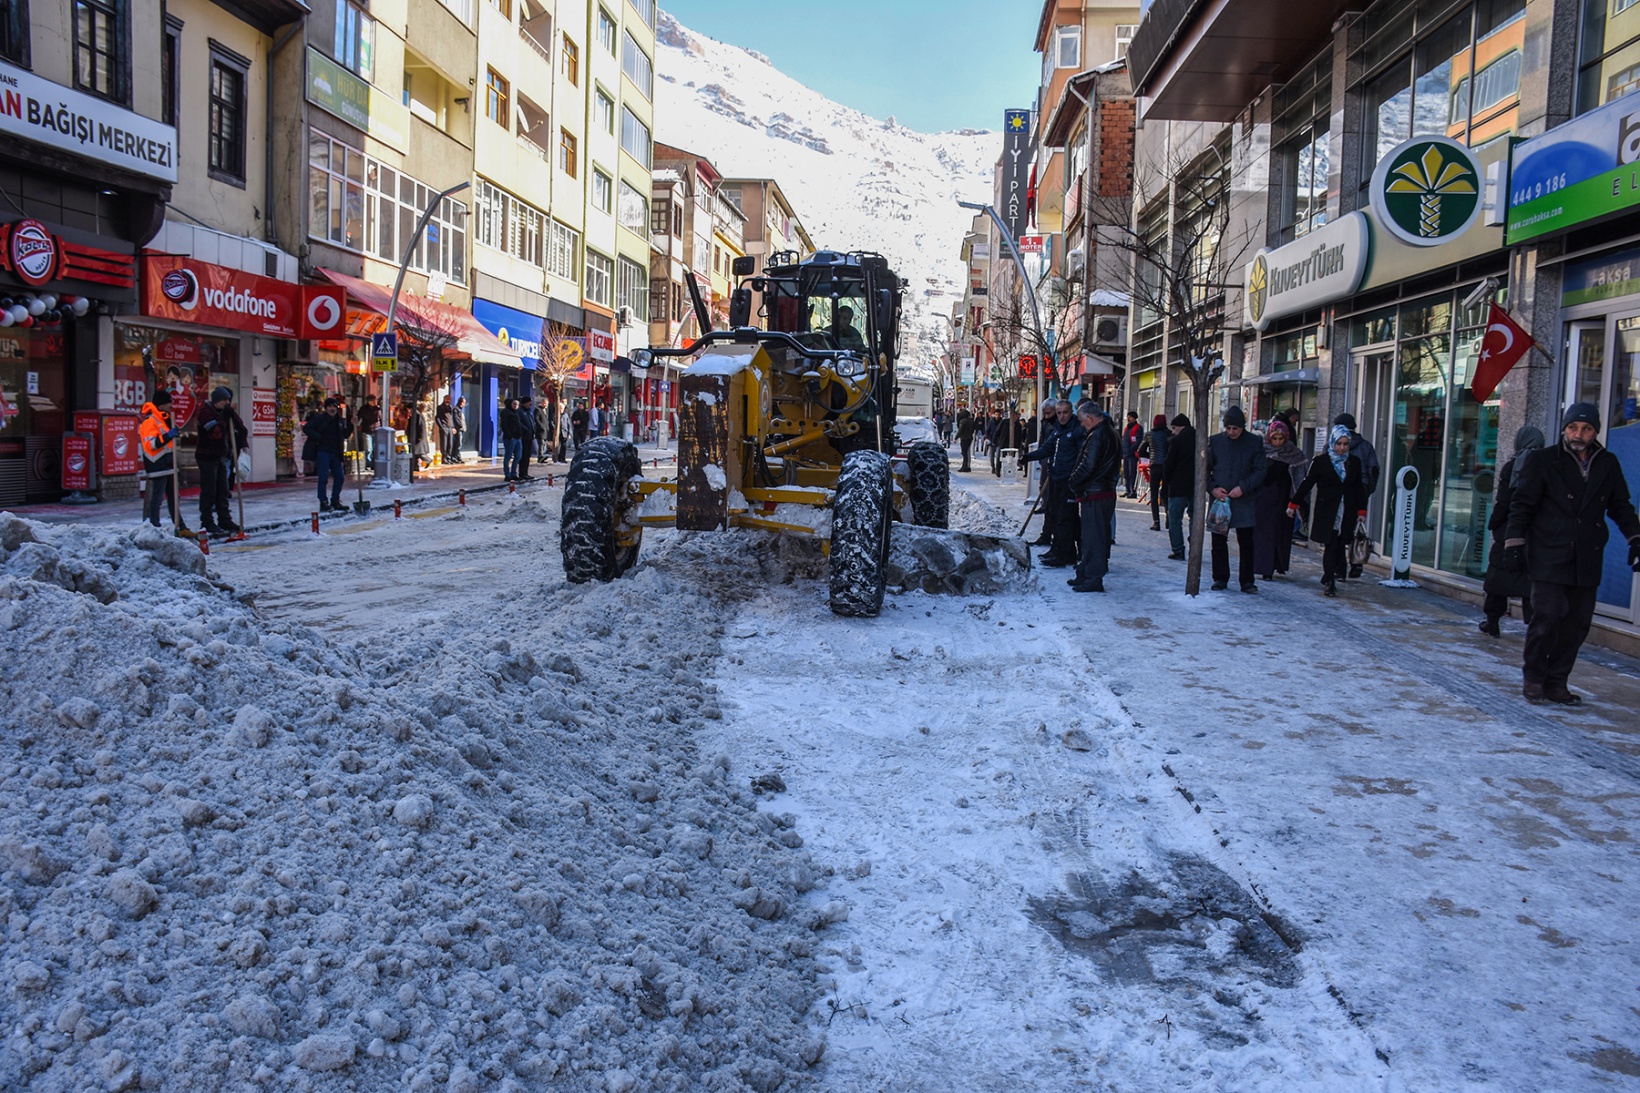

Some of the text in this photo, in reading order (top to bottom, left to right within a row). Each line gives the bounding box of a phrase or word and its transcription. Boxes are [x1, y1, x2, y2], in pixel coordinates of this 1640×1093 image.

[27, 96, 94, 144] BAĞIŞI
[99, 122, 172, 168] MERKEZİ
[1512, 172, 1566, 206] 444 9 186
[1598, 266, 1631, 286] aksa
[203, 285, 276, 319] vodafone
